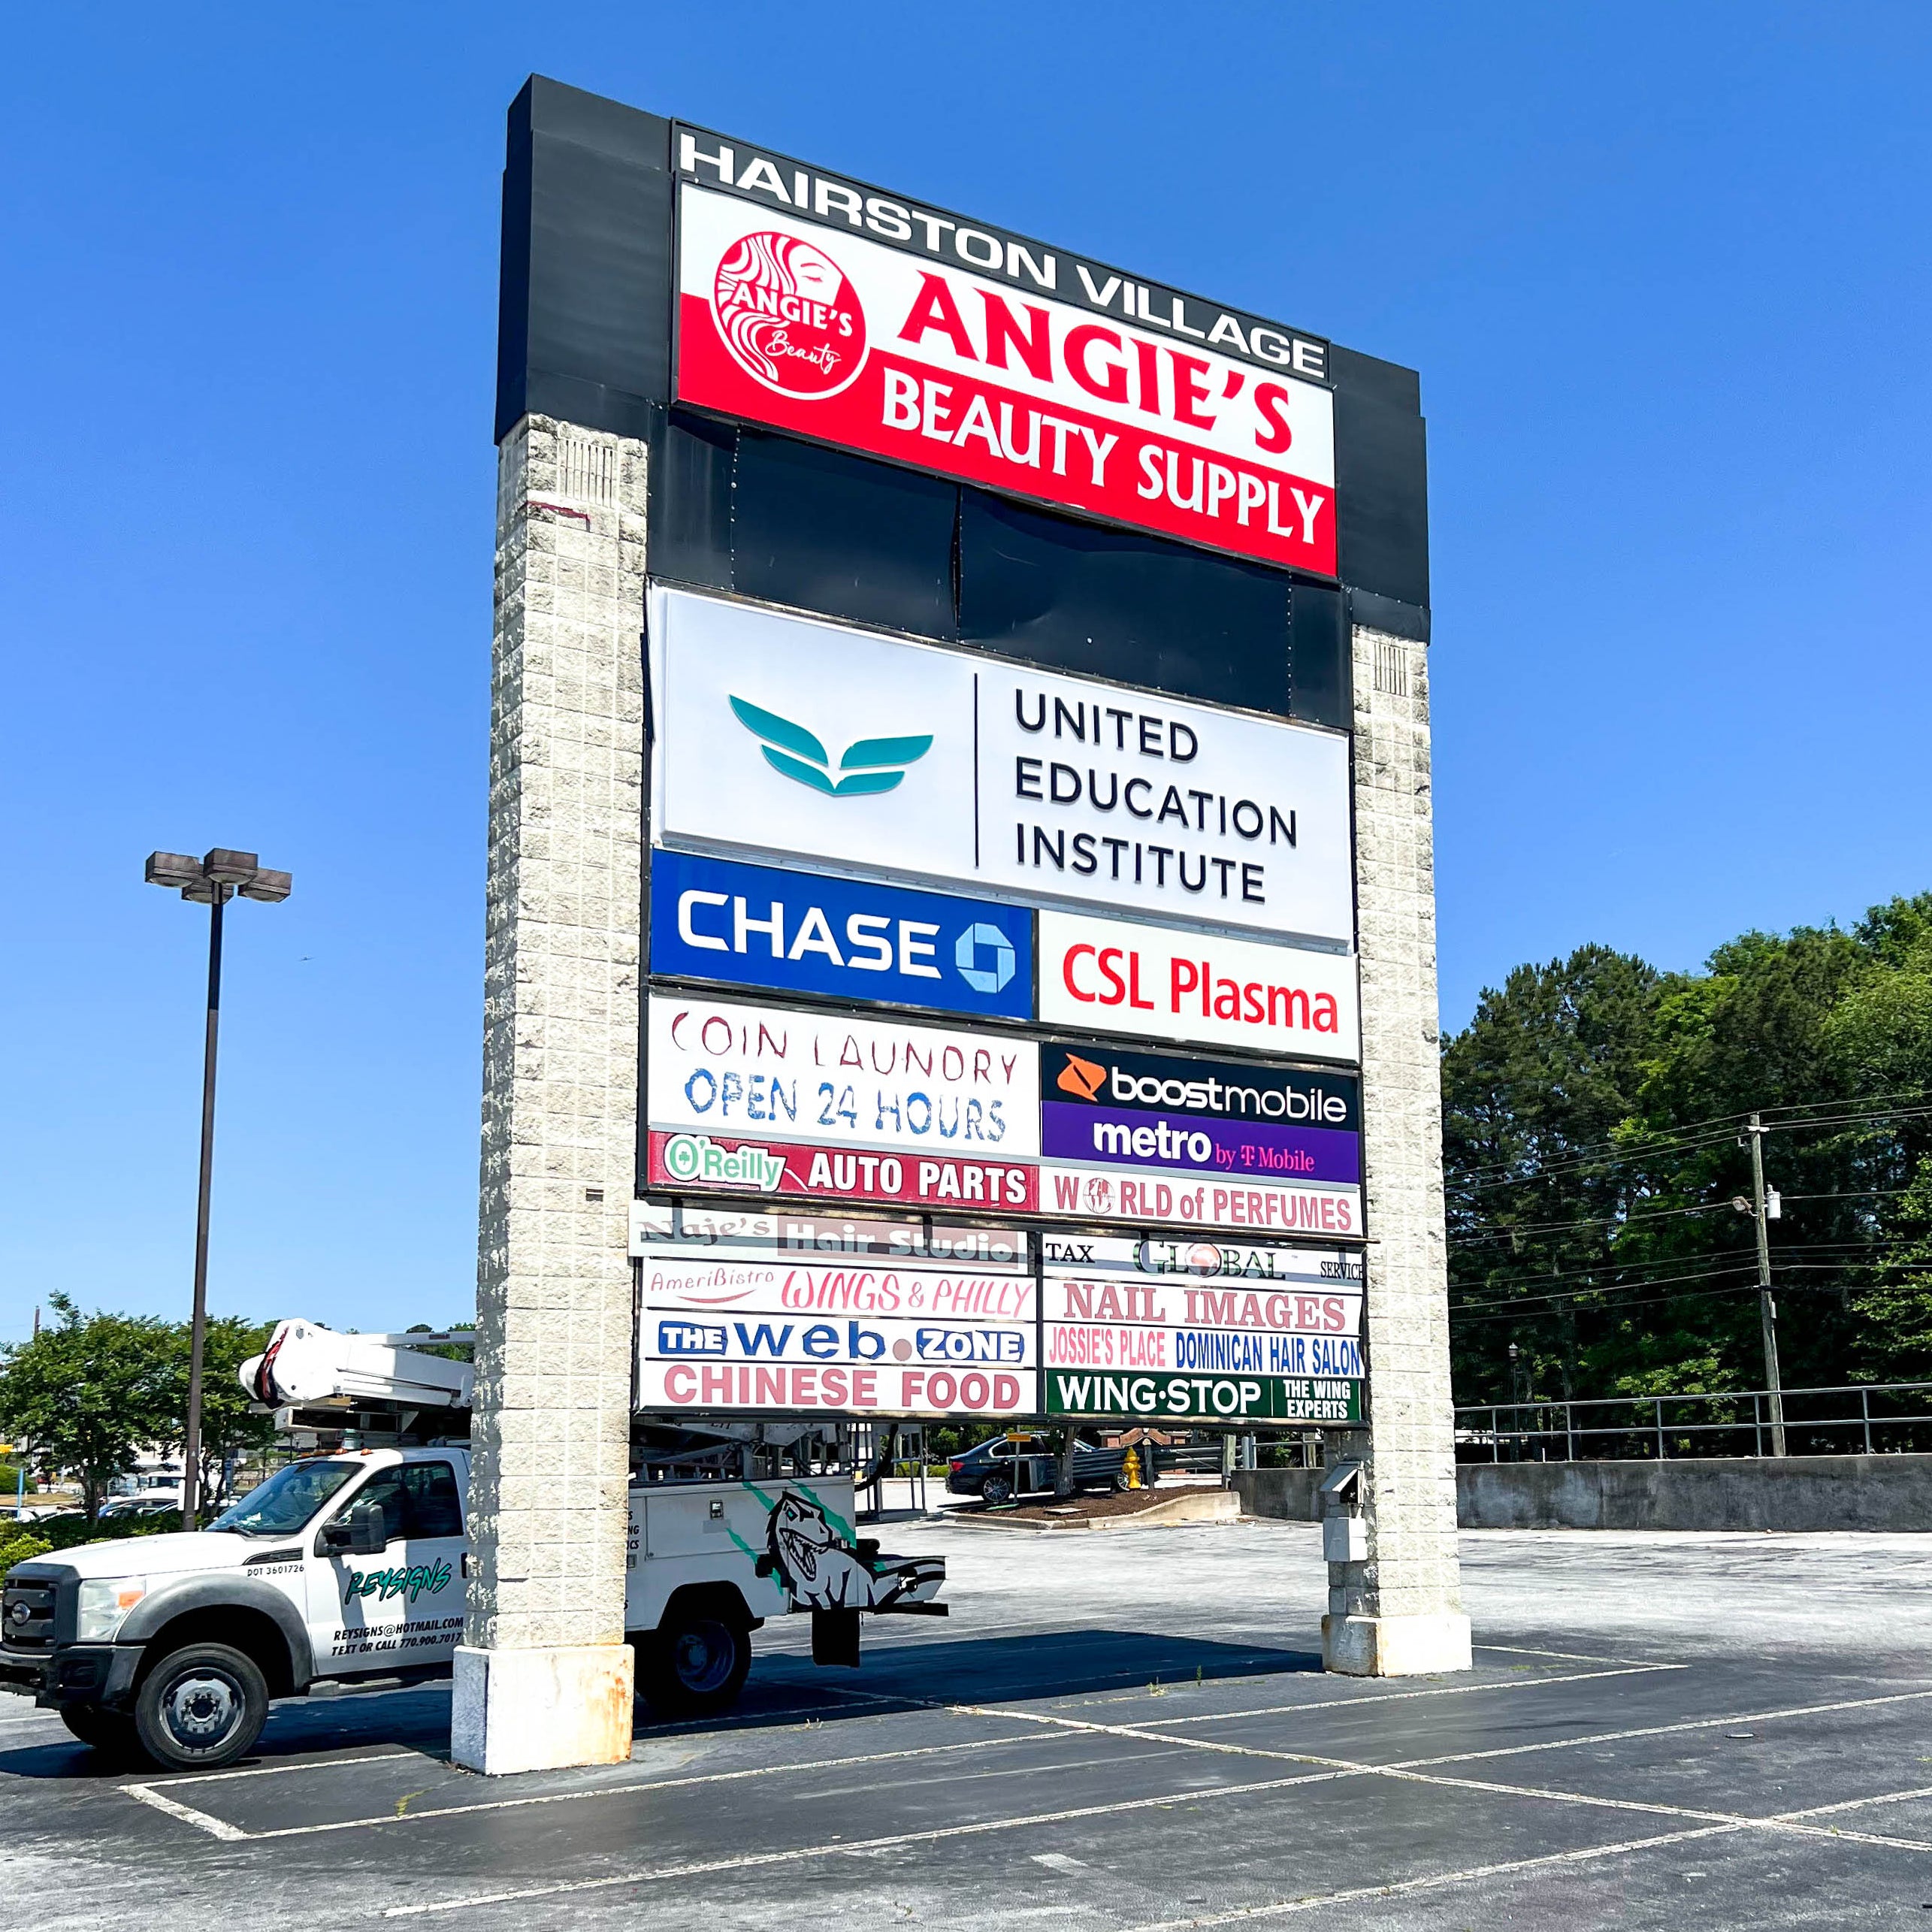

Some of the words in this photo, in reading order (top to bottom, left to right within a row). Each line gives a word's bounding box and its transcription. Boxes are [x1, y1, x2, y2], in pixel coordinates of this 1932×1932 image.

[680, 133, 1056, 290] HAIRSTON
[1076, 265, 1325, 378] VILLAGE
[732, 282, 852, 337] ANGIE'S
[765, 330, 841, 374] Beauty
[897, 270, 1293, 453] ANGIE'S
[882, 367, 1118, 487] BEAUTY
[1137, 444, 1324, 545] SUPPLY
[1016, 689, 1198, 763] UNITED
[1016, 756, 1296, 848] EDUCATION
[1017, 823, 1265, 904] INSTITUTE
[678, 890, 942, 978] CHASE
[1063, 943, 1154, 1011] CSL
[1171, 957, 1338, 1033] Plasma
[672, 1011, 786, 1059] COIN
[815, 1035, 1017, 1084] LAUNDRY
[685, 1069, 797, 1122] OPEN
[818, 1082, 857, 1129] 24
[875, 1090, 1006, 1142] HOURS
[1093, 1121, 1211, 1162] metro
[1215, 1143, 1236, 1170] by
[670, 1139, 779, 1186] O'Reilly
[808, 1152, 902, 1194] AUTO
[918, 1163, 1027, 1203] PARTS
[1181, 1187, 1205, 1220] of
[1214, 1189, 1351, 1231] PERFUMES
[636, 1217, 769, 1246] Naje's
[786, 1223, 876, 1254] Hair
[889, 1226, 1014, 1262] Studio
[1045, 1243, 1096, 1263] TAX
[1132, 1239, 1286, 1280] GLOBAL
[650, 1268, 774, 1292] AmeriBistro
[782, 1270, 900, 1311] WINGS
[909, 1282, 924, 1308] &
[933, 1279, 1035, 1318] PHILLY
[1063, 1283, 1166, 1322] NAIL
[1184, 1290, 1346, 1332] IMAGES
[661, 1326, 726, 1351] THE
[1049, 1326, 1113, 1365] JOSSIE'S
[1120, 1329, 1166, 1367] PLACE
[1175, 1332, 1262, 1372] DOMINICAN
[1270, 1338, 1305, 1374] HAIR
[1312, 1339, 1360, 1376] SALON
[664, 1365, 878, 1407] CHINESE
[901, 1371, 1020, 1410] FOOD
[1283, 1379, 1310, 1399] THE
[1313, 1380, 1351, 1401] WING
[1287, 1399, 1348, 1419] EXPERTS
[247, 1568, 263, 1577] DOT
[266, 1565, 304, 1575] 3601726
[344, 1557, 452, 1605] REYSIGNS
[331, 1643, 358, 1656] TEXT
[359, 1642, 373, 1653] OR
[375, 1640, 397, 1652] CALL
[399, 1632, 462, 1649] 770.900.7017
[334, 1617, 464, 1641] REYSIGNS@HOTMAIL.COM
